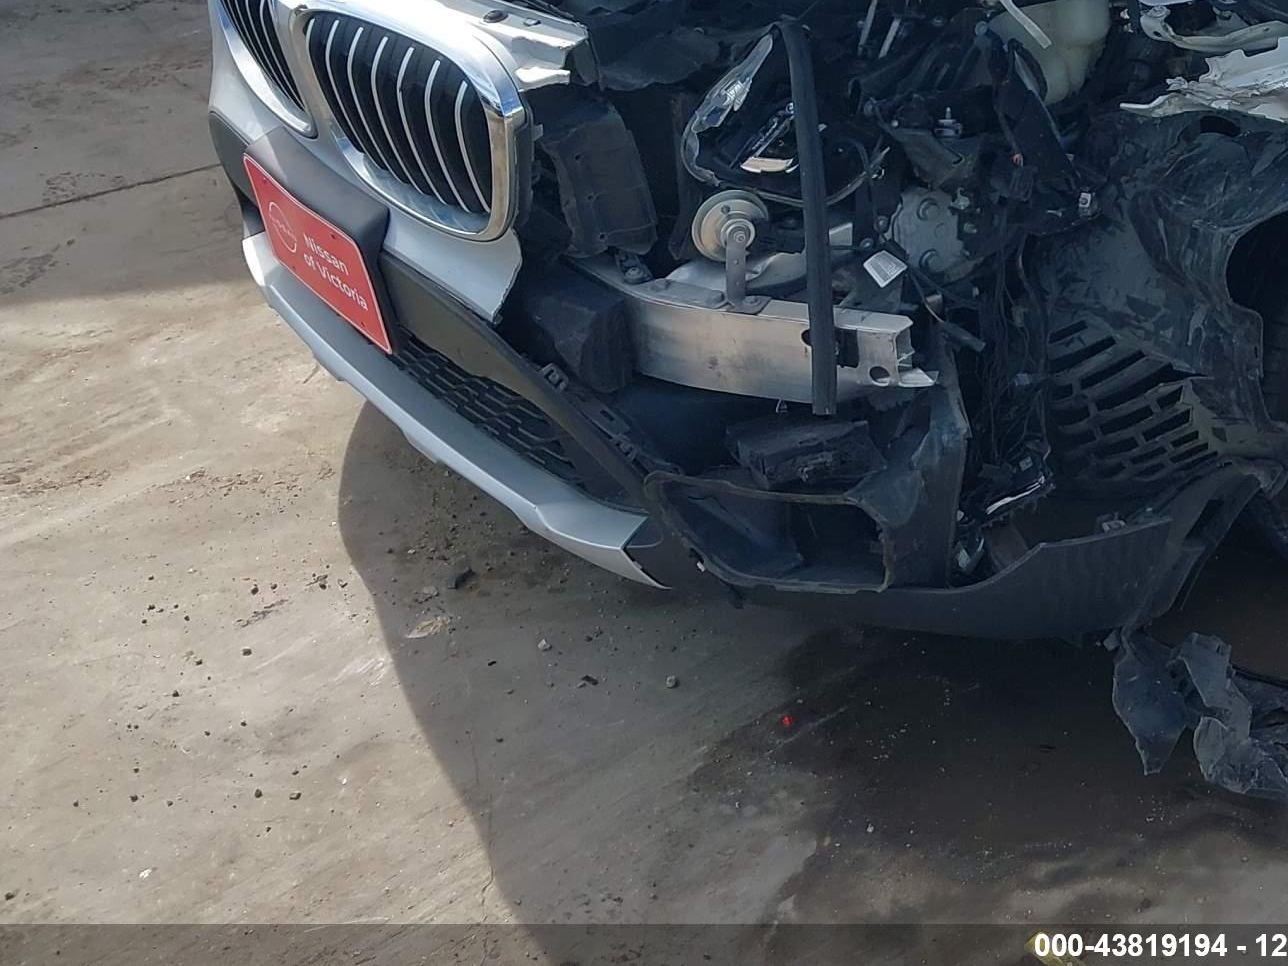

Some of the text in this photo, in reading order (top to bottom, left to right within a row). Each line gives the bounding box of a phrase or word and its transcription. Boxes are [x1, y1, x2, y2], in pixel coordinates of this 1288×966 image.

[303, 233, 350, 276] Nissan
[303, 254, 369, 312] of Victoria
